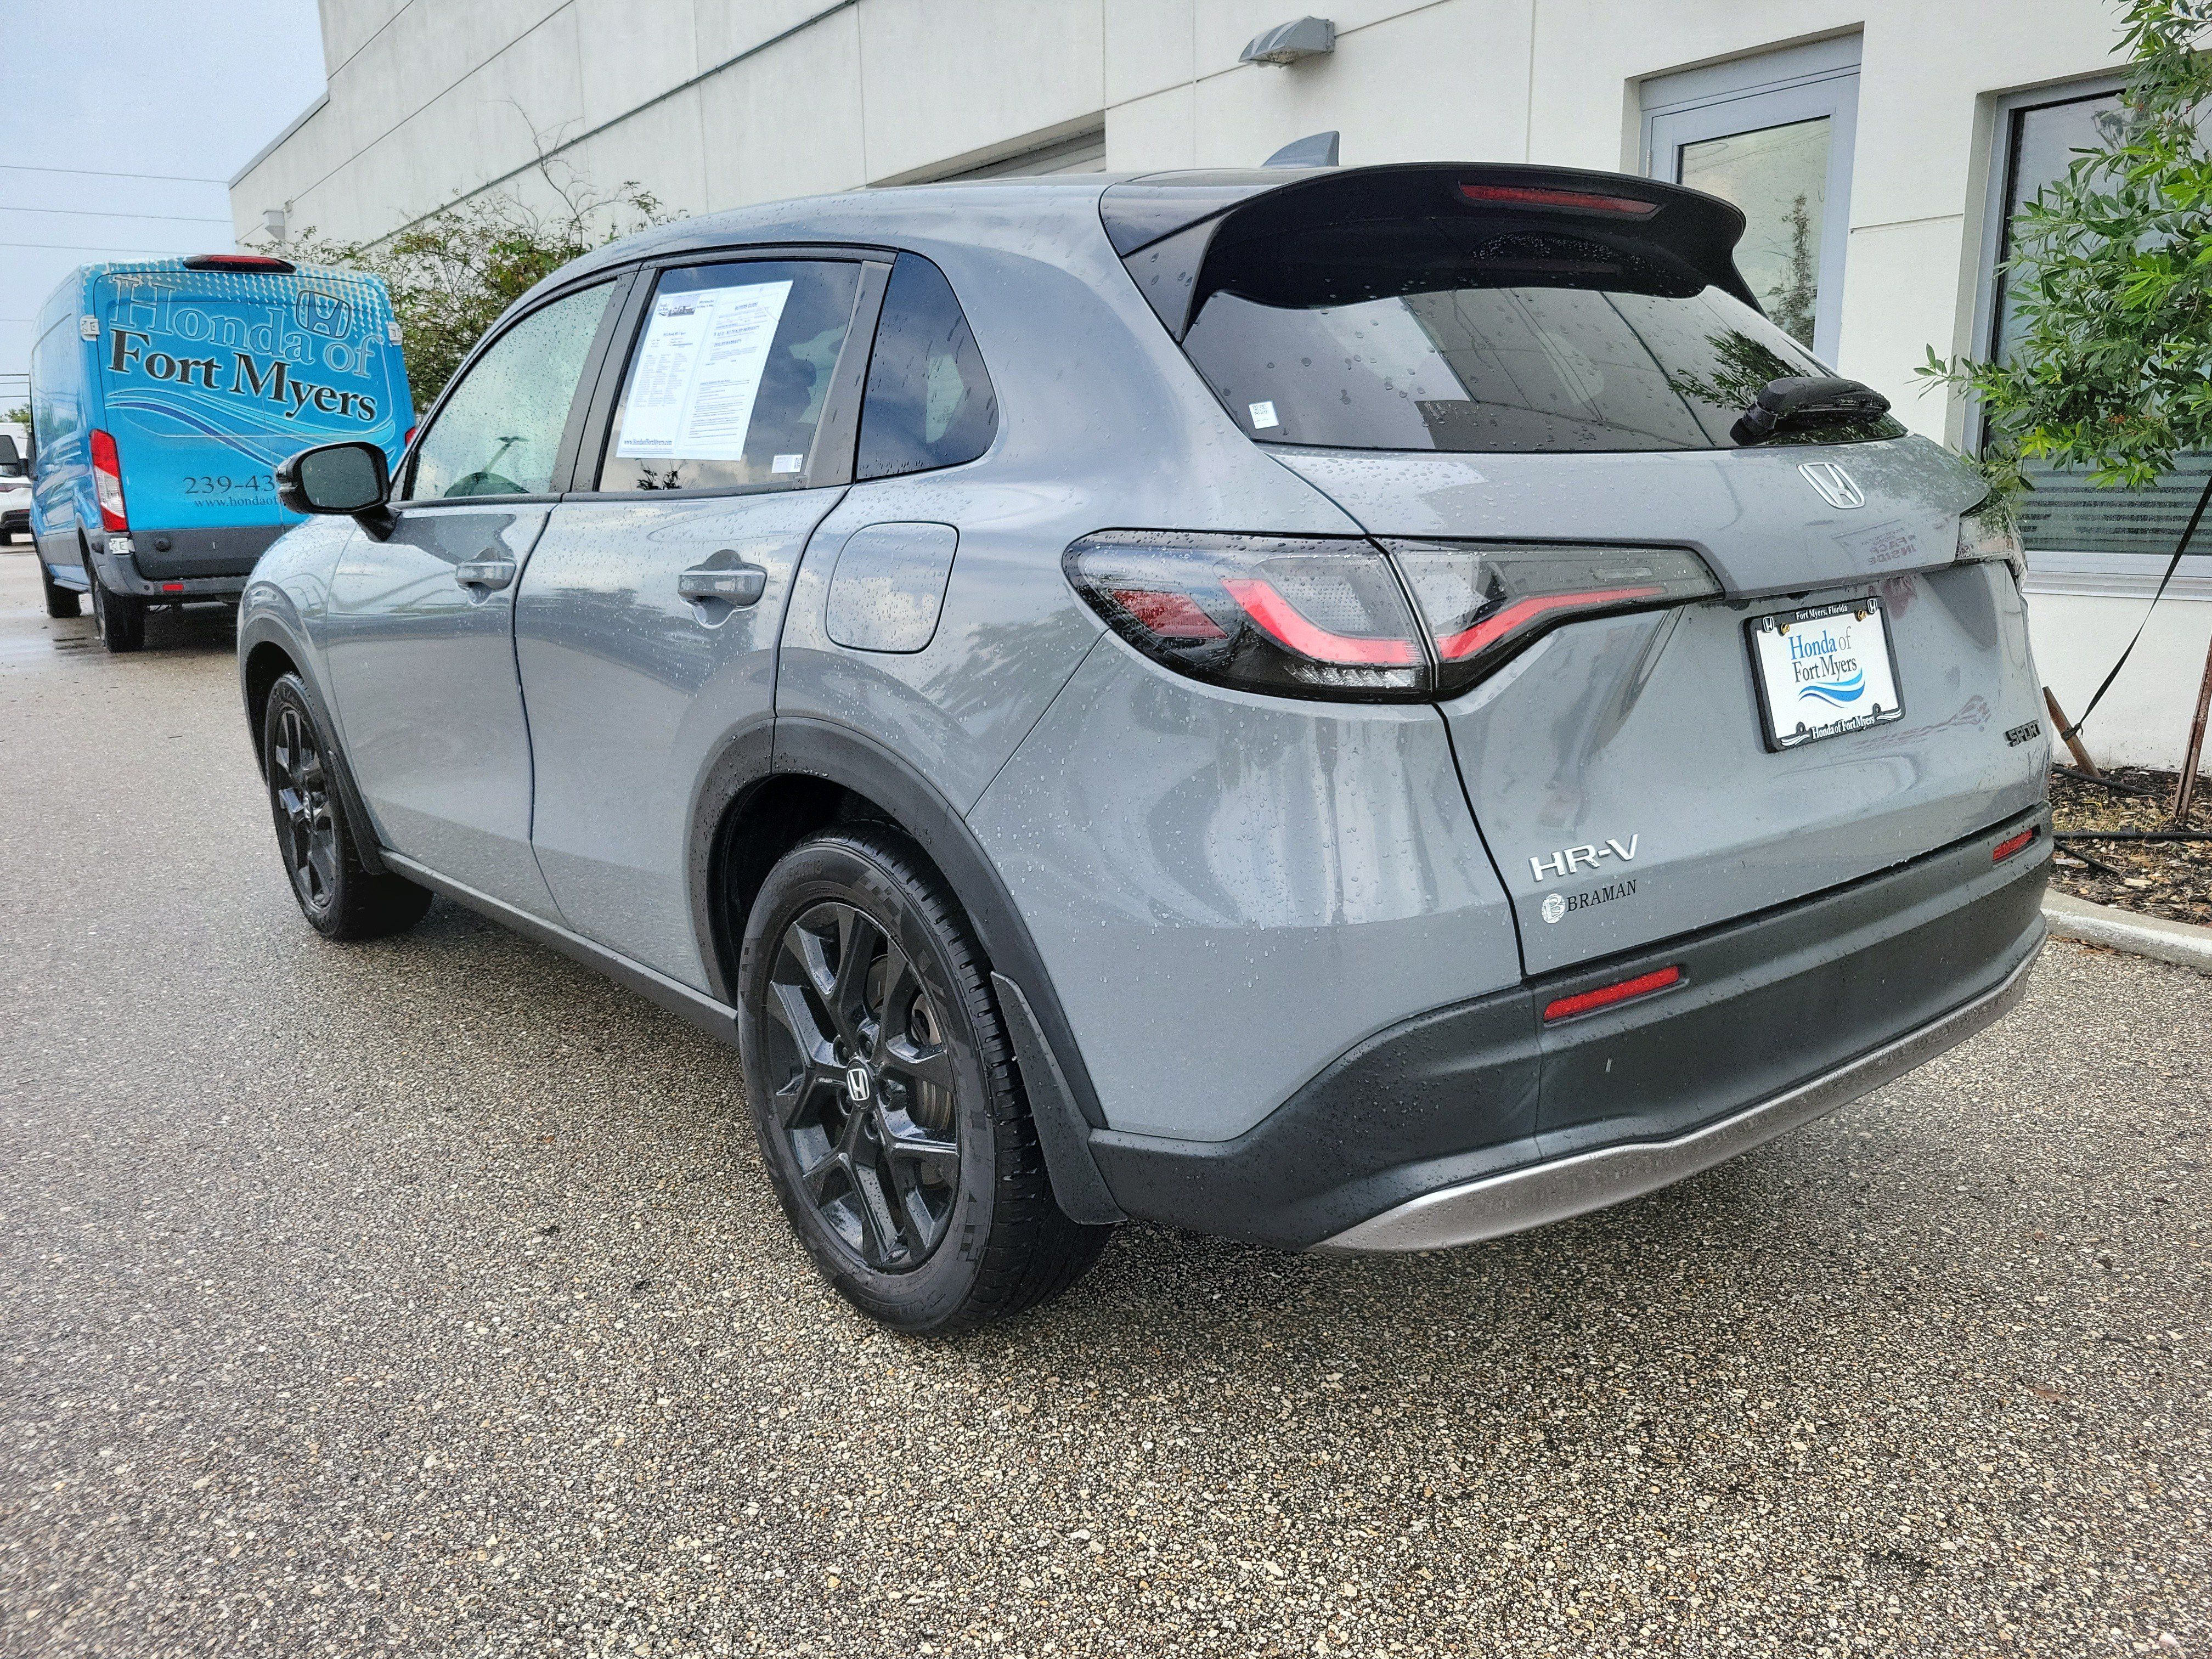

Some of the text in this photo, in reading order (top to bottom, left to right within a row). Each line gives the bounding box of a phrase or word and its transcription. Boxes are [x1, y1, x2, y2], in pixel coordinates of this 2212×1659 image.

[110, 276, 383, 379] Honda of
[108, 329, 376, 421] Fort Myers
[1796, 612, 1808, 620] Fort
[1828, 604, 1848, 614] Florida
[1788, 626, 1852, 660] Honda of
[1792, 654, 1857, 682] Fort Myers
[1811, 715, 1875, 739] Honda of Fort Myers
[2005, 719, 2041, 747] SPORT
[1528, 834, 1638, 882] HR-V
[1566, 879, 1637, 912] BRAMAN
